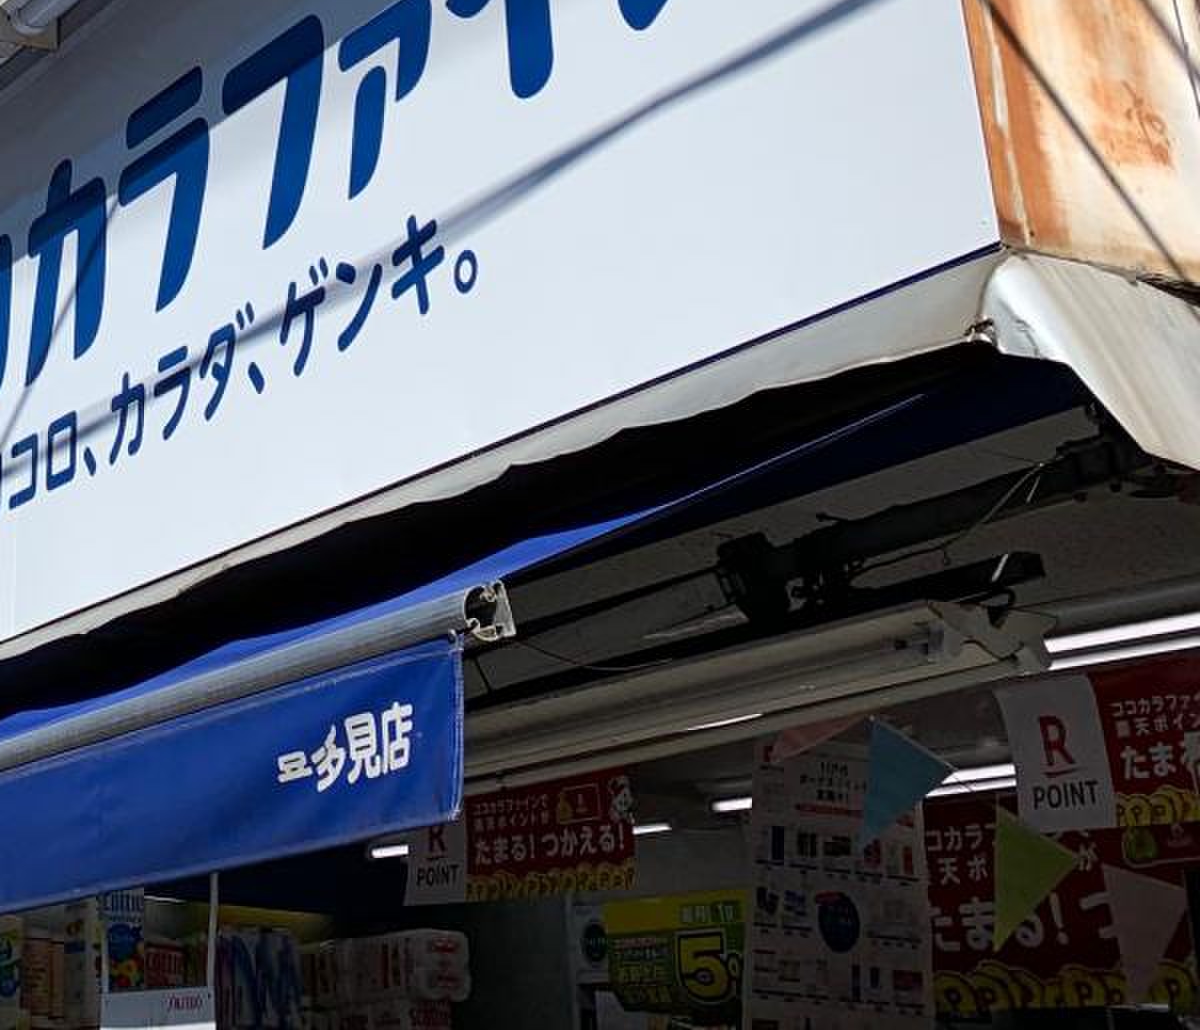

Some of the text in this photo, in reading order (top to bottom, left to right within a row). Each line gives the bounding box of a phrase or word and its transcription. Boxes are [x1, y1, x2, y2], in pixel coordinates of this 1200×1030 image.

[1037, 715, 1076, 767] R
[1033, 780, 1099, 809] POINT
[415, 864, 459, 888] POINT
